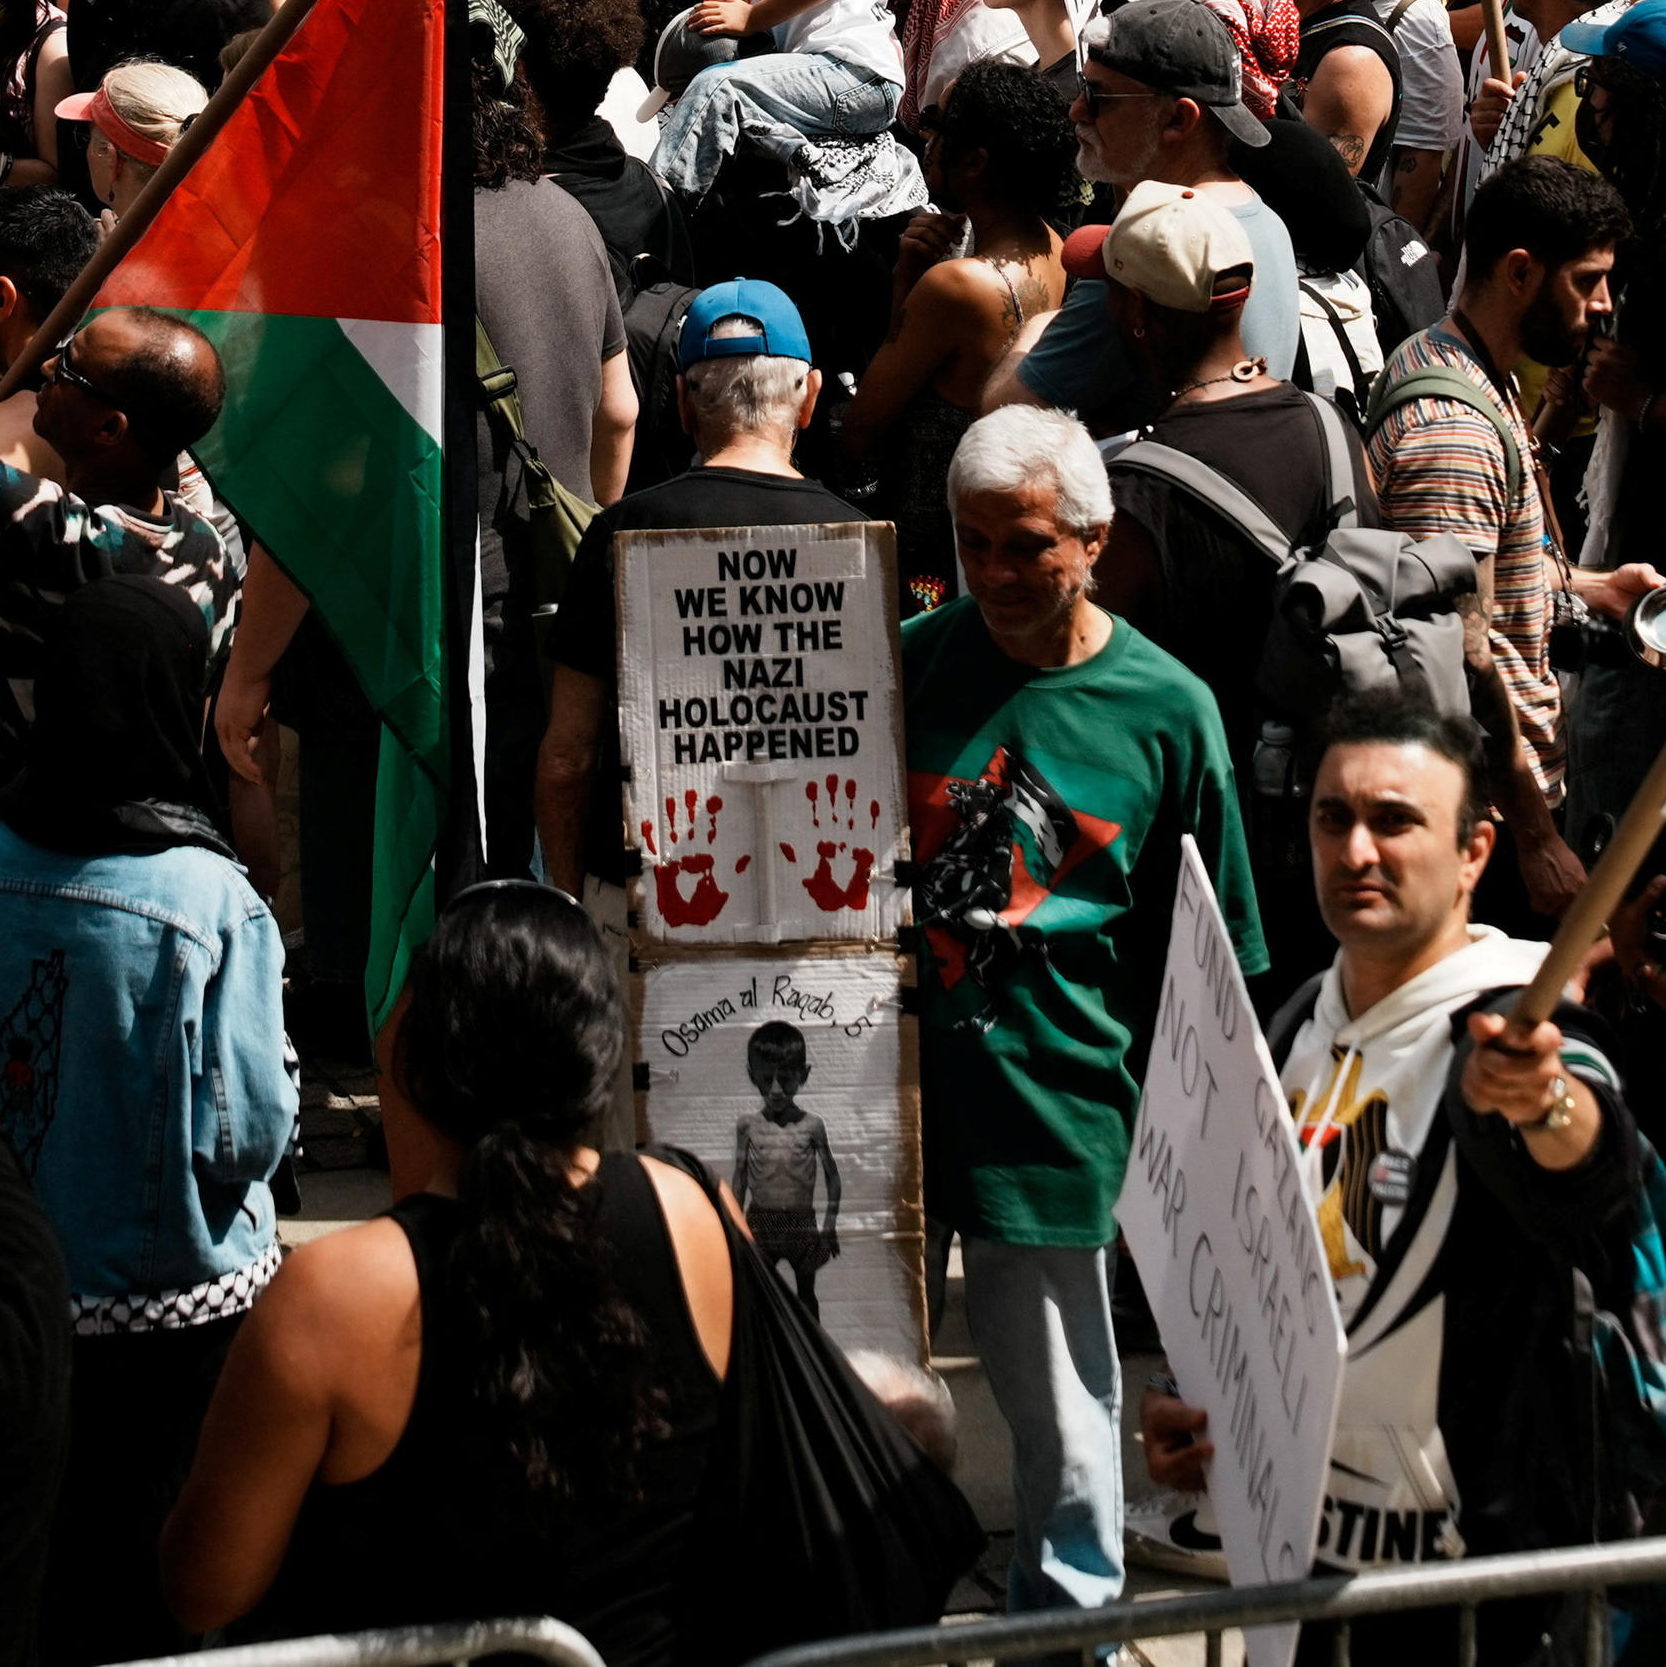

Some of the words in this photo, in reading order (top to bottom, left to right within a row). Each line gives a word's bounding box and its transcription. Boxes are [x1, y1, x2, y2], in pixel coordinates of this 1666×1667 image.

[719, 548, 797, 581] NOW
[675, 586, 729, 619] WE
[739, 582, 845, 617] KNOW
[683, 623, 763, 657] HOW
[773, 620, 843, 653] THE
[723, 657, 804, 689] NAZI
[659, 690, 869, 730] HOLOCAUST
[674, 726, 861, 765] HAPPENED
[1179, 858, 1240, 1044] FUND
[661, 997, 734, 1058] Osama
[738, 976, 758, 1008] al
[844, 1015, 873, 1038] 5
[1139, 1112, 1187, 1260] WAR
[1162, 977, 1220, 1138] NOT
[1230, 1149, 1309, 1437] ISRAELI
